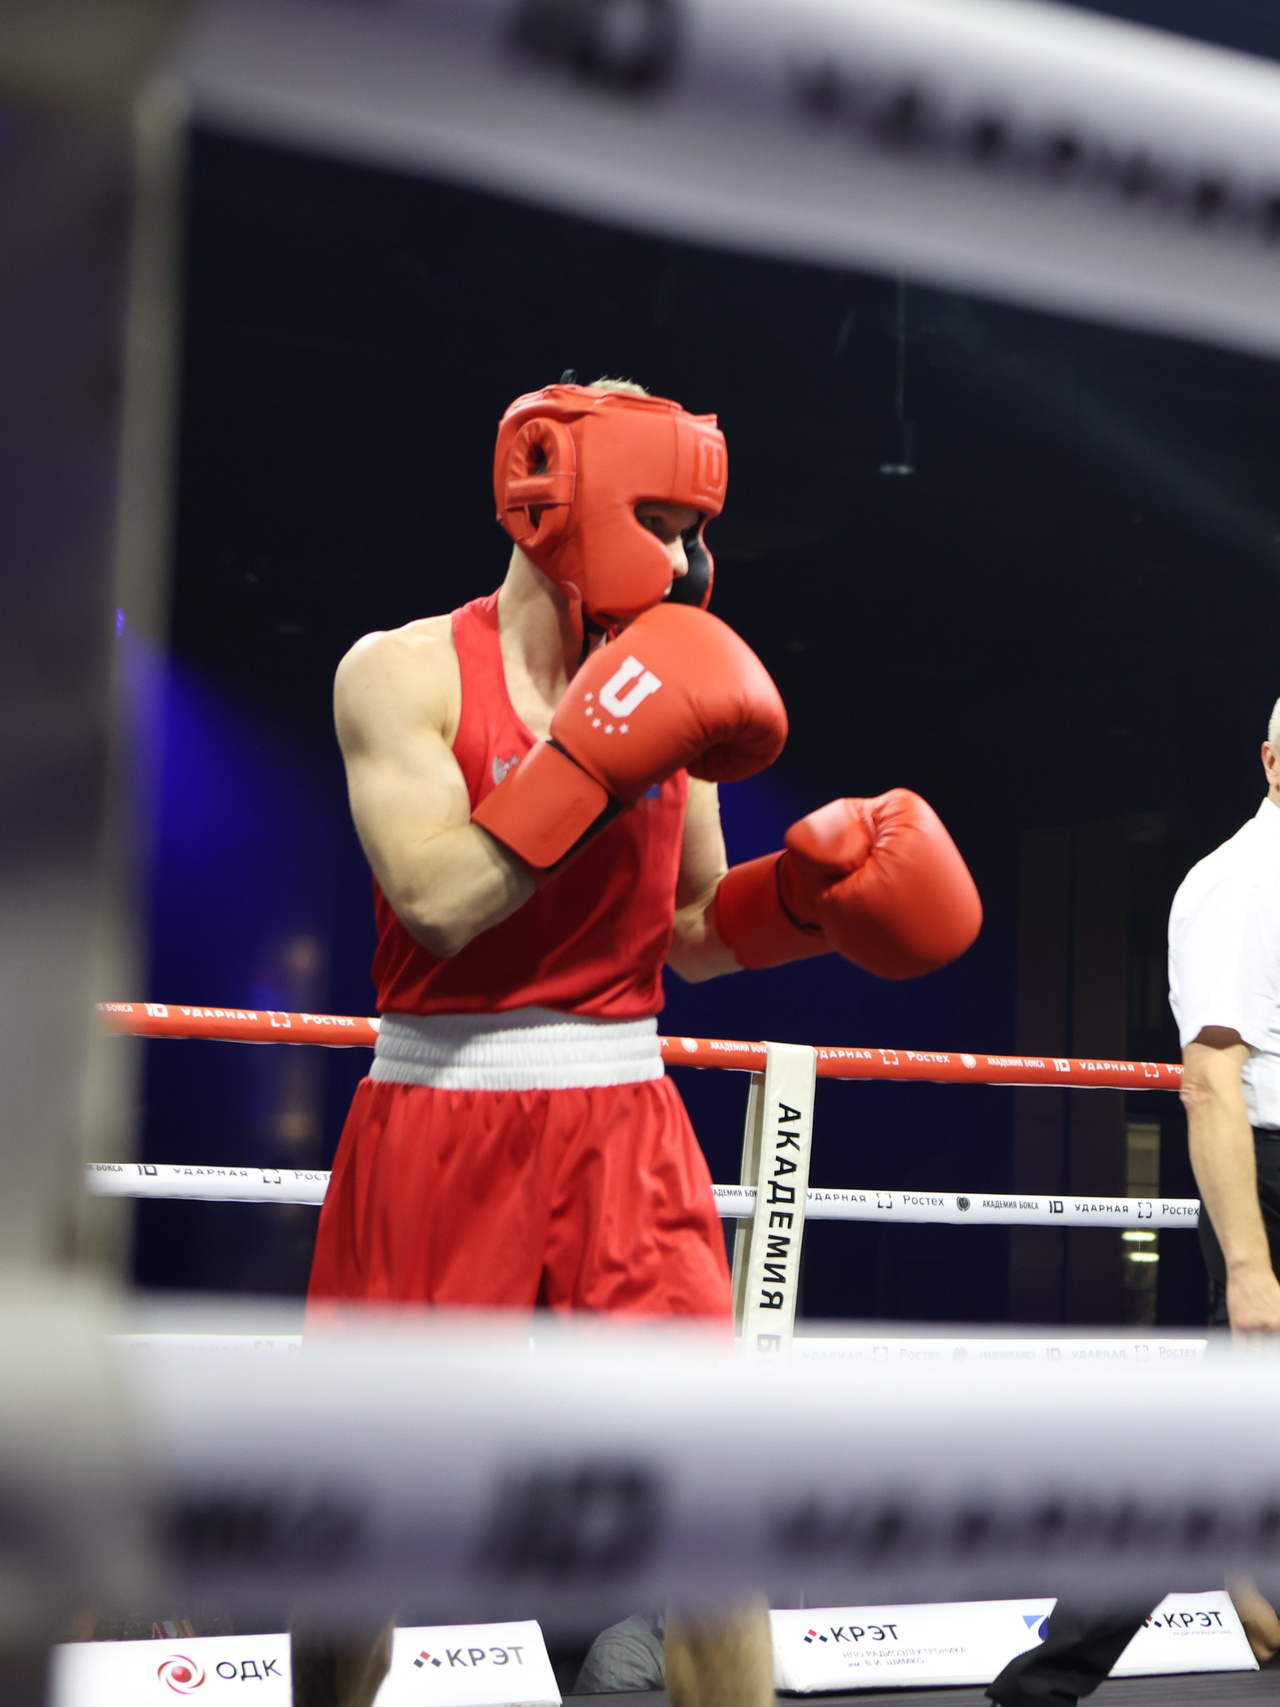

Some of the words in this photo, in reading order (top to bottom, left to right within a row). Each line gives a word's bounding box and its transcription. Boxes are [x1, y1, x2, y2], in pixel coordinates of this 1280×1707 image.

[598, 655, 663, 718] U
[180, 1007, 258, 1020] УДАРНАЯ
[301, 1013, 355, 1026] Ростех
[710, 1040, 750, 1052] АКАДЕМИЯ
[750, 1044, 767, 1054] БОК
[818, 1050, 872, 1060] ДАРНАЯ
[907, 1051, 950, 1063] Ростех
[987, 1056, 1024, 1068] АКАДЕМИЯ
[1025, 1058, 1045, 1068] БОКСА
[1079, 1061, 1135, 1073] УДАРНАЯ
[172, 1167, 249, 1178] УДАРНАЯ
[294, 1171, 332, 1181] Рост
[713, 1188, 743, 1197] АДЕМИЯ
[745, 1190, 758, 1198] БОК
[806, 1193, 867, 1204] УДАРНАЯ
[903, 1194, 945, 1206] Ростех
[982, 1199, 1018, 1210] АКАДЕМИЯ
[1019, 1200, 1040, 1210] БОКСА
[1074, 1202, 1130, 1214] УДАРНАЯ
[1162, 1203, 1200, 1216] Ростех
[759, 1102, 802, 1310] АКАДЕМИЯ
[802, 1350, 863, 1361] УДАРНАЯ
[899, 1347, 942, 1361] Ростех
[1071, 1349, 1126, 1360] УДАРНАЯ
[1158, 1345, 1197, 1359] Ростех
[1162, 1611, 1224, 1629] КРЭТ
[829, 1624, 899, 1643] КРЭТ
[445, 1645, 525, 1669] КРЭТ
[842, 1650, 864, 1659] НПО
[215, 1657, 283, 1682] ОДК
